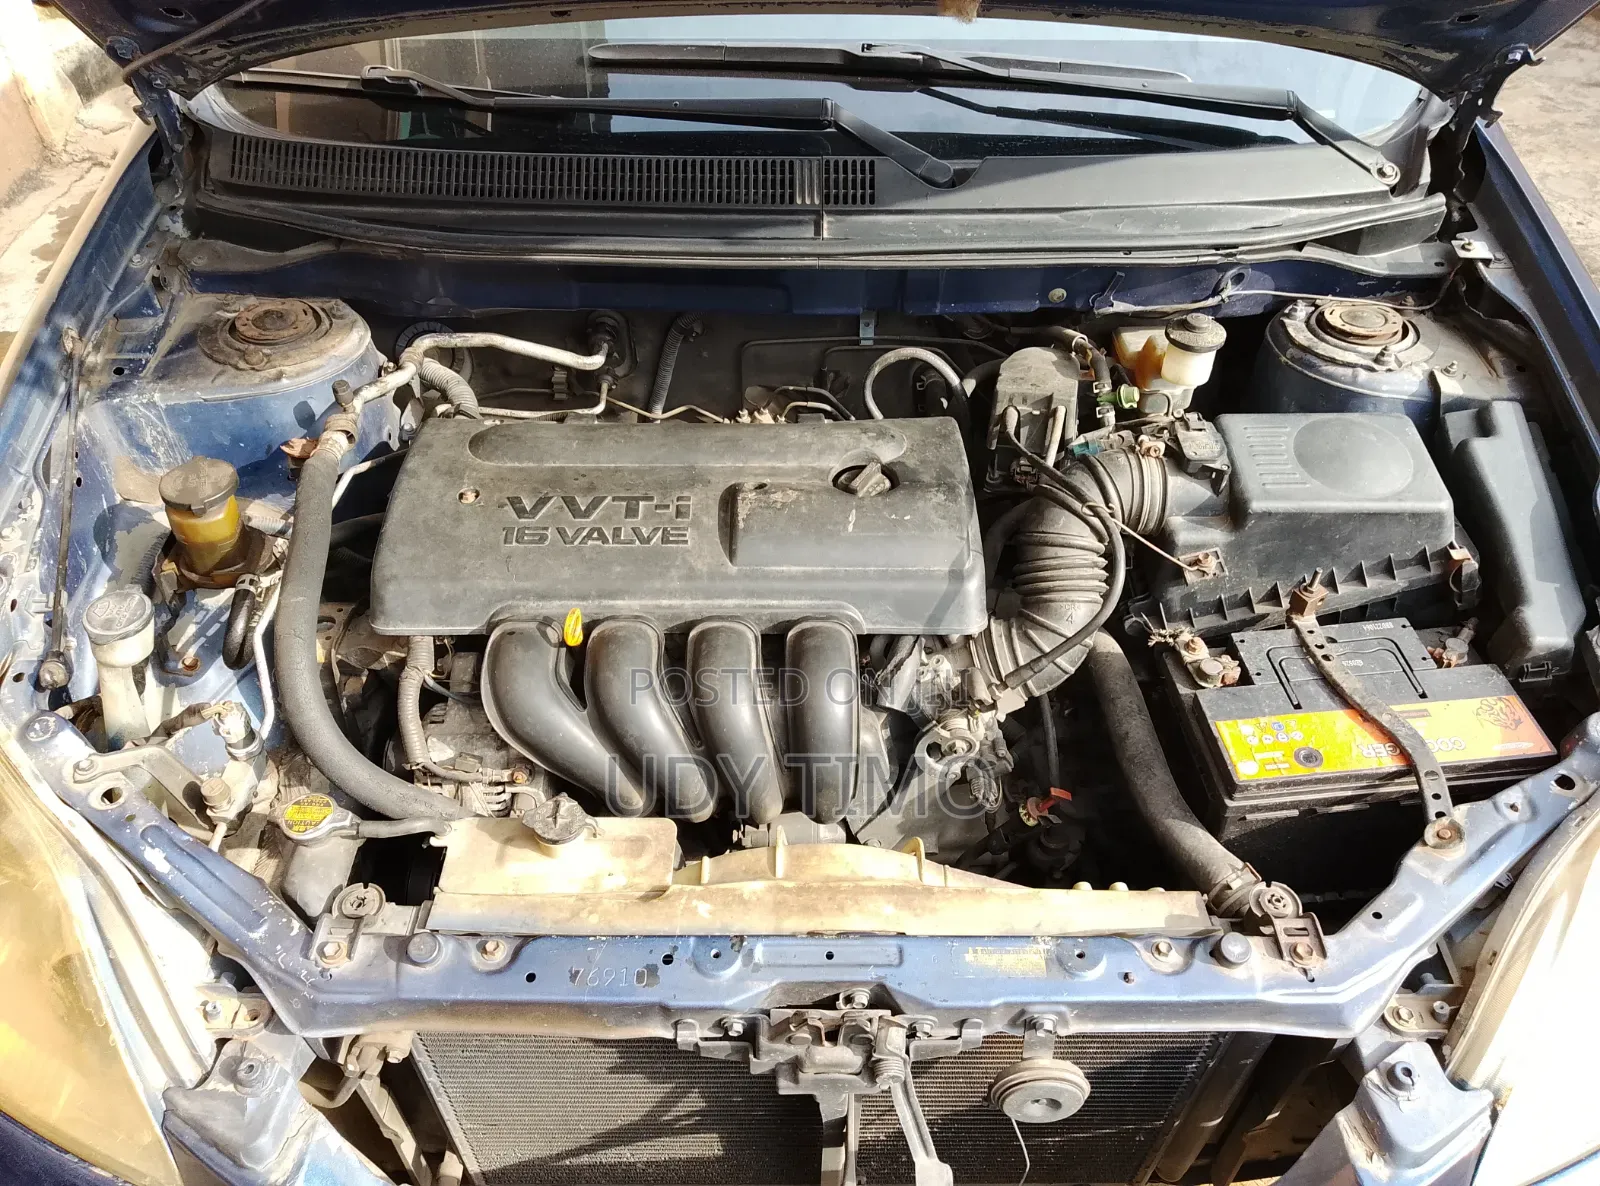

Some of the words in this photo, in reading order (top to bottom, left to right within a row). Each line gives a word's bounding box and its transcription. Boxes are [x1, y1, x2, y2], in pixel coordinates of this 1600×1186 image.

[506, 495, 693, 521] VVT-i
[502, 526, 551, 546] 16
[556, 526, 691, 546] VALVE
[572, 967, 648, 987] 76910
